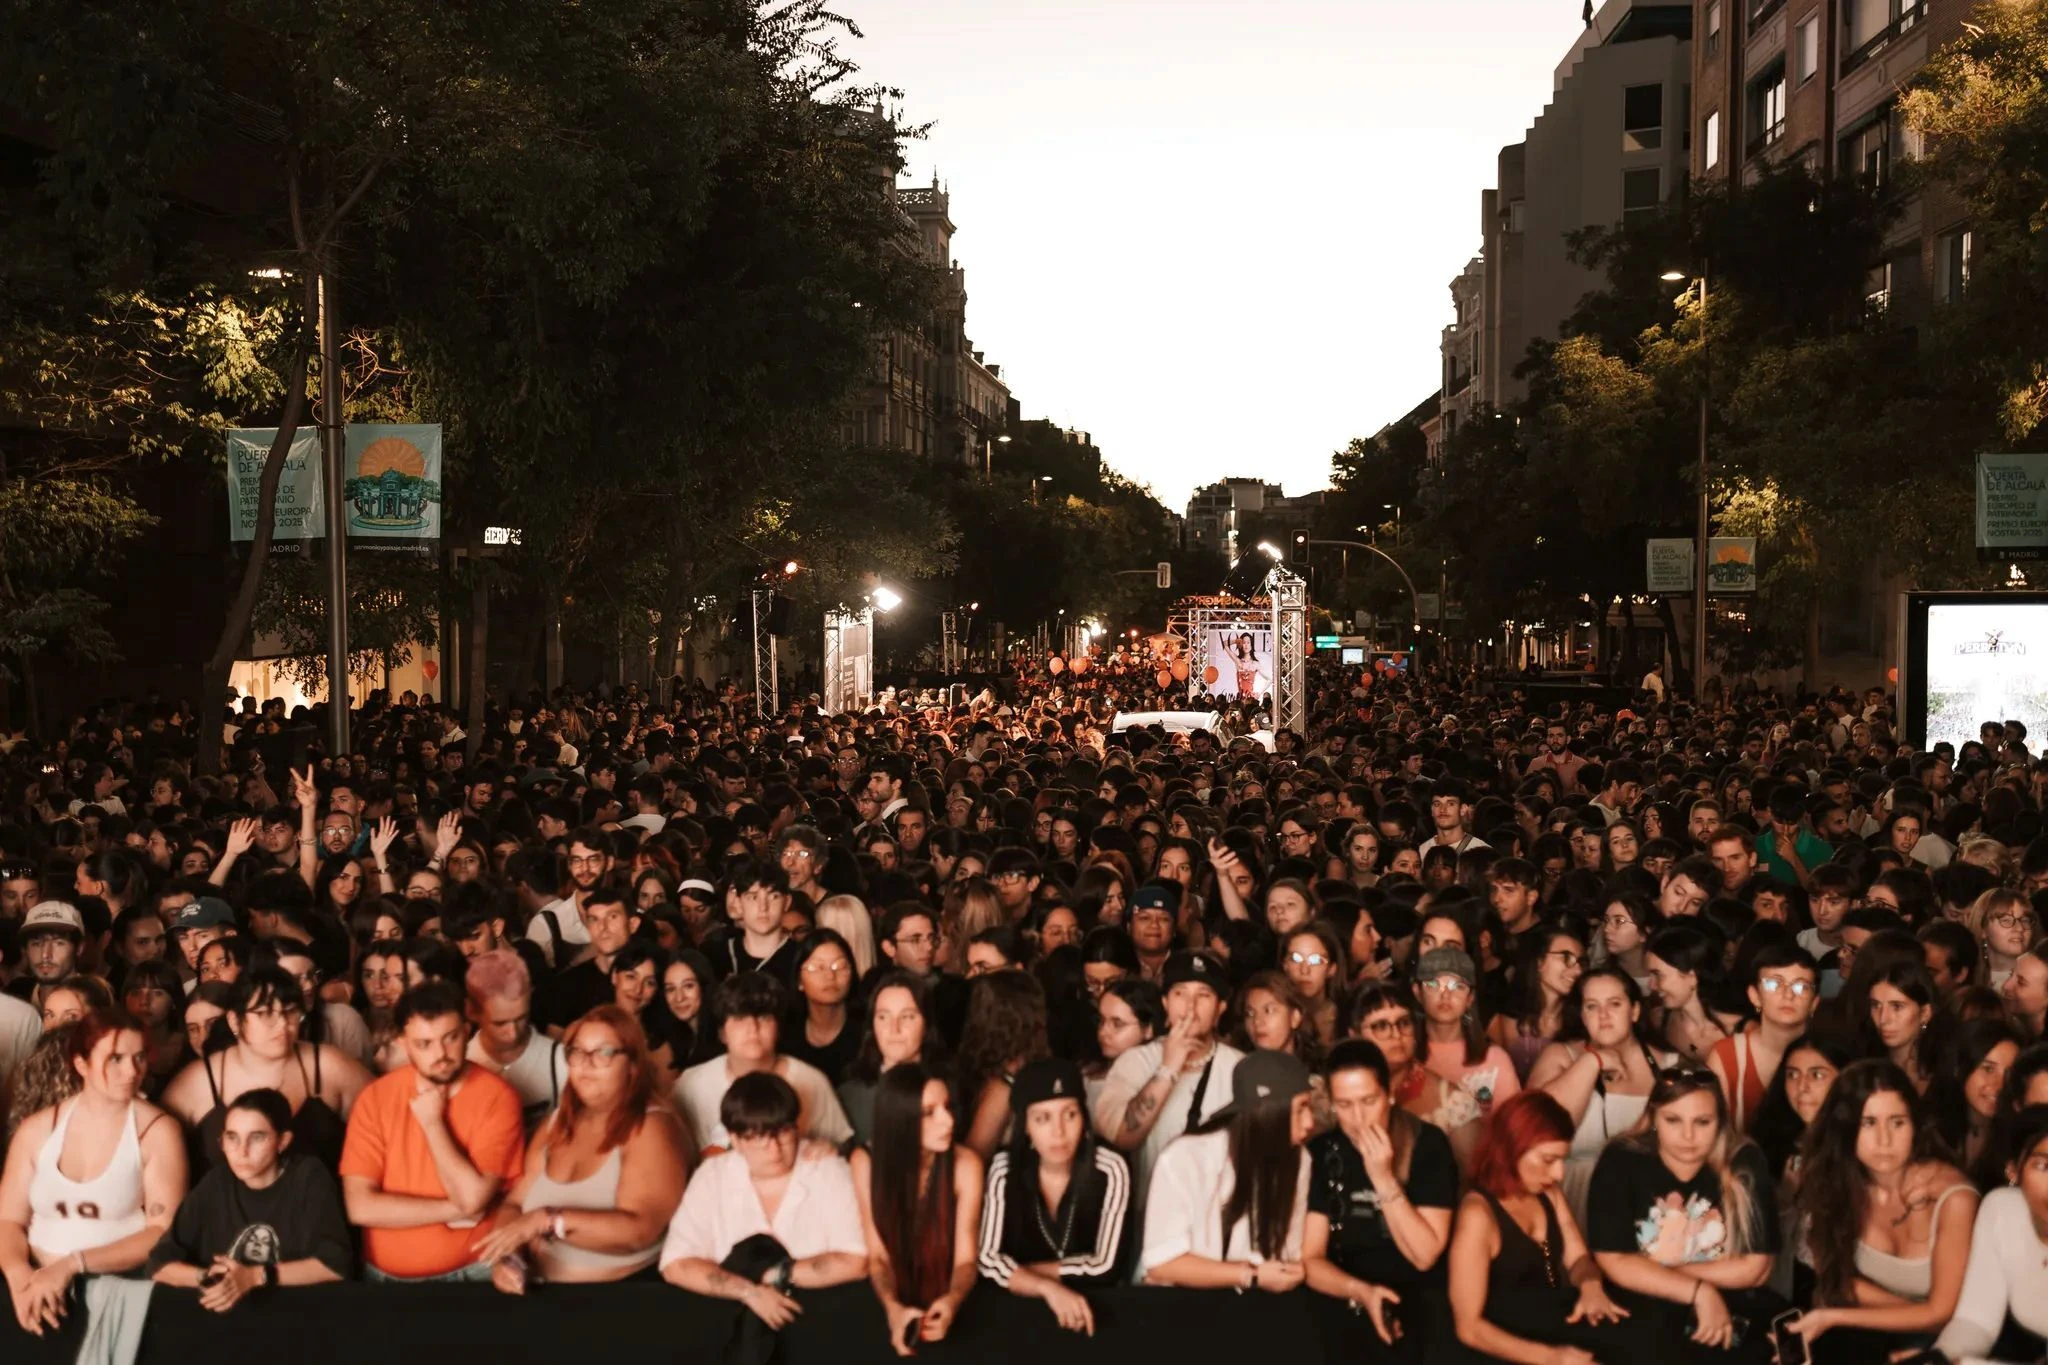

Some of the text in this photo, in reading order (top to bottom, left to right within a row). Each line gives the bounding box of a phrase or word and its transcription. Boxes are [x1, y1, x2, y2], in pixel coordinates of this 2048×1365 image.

[239, 462, 253, 473] DE
[284, 486, 297, 495] DE
[1987, 481, 2001, 491] DE
[276, 507, 314, 517] EUROPA
[279, 517, 304, 528] 2025
